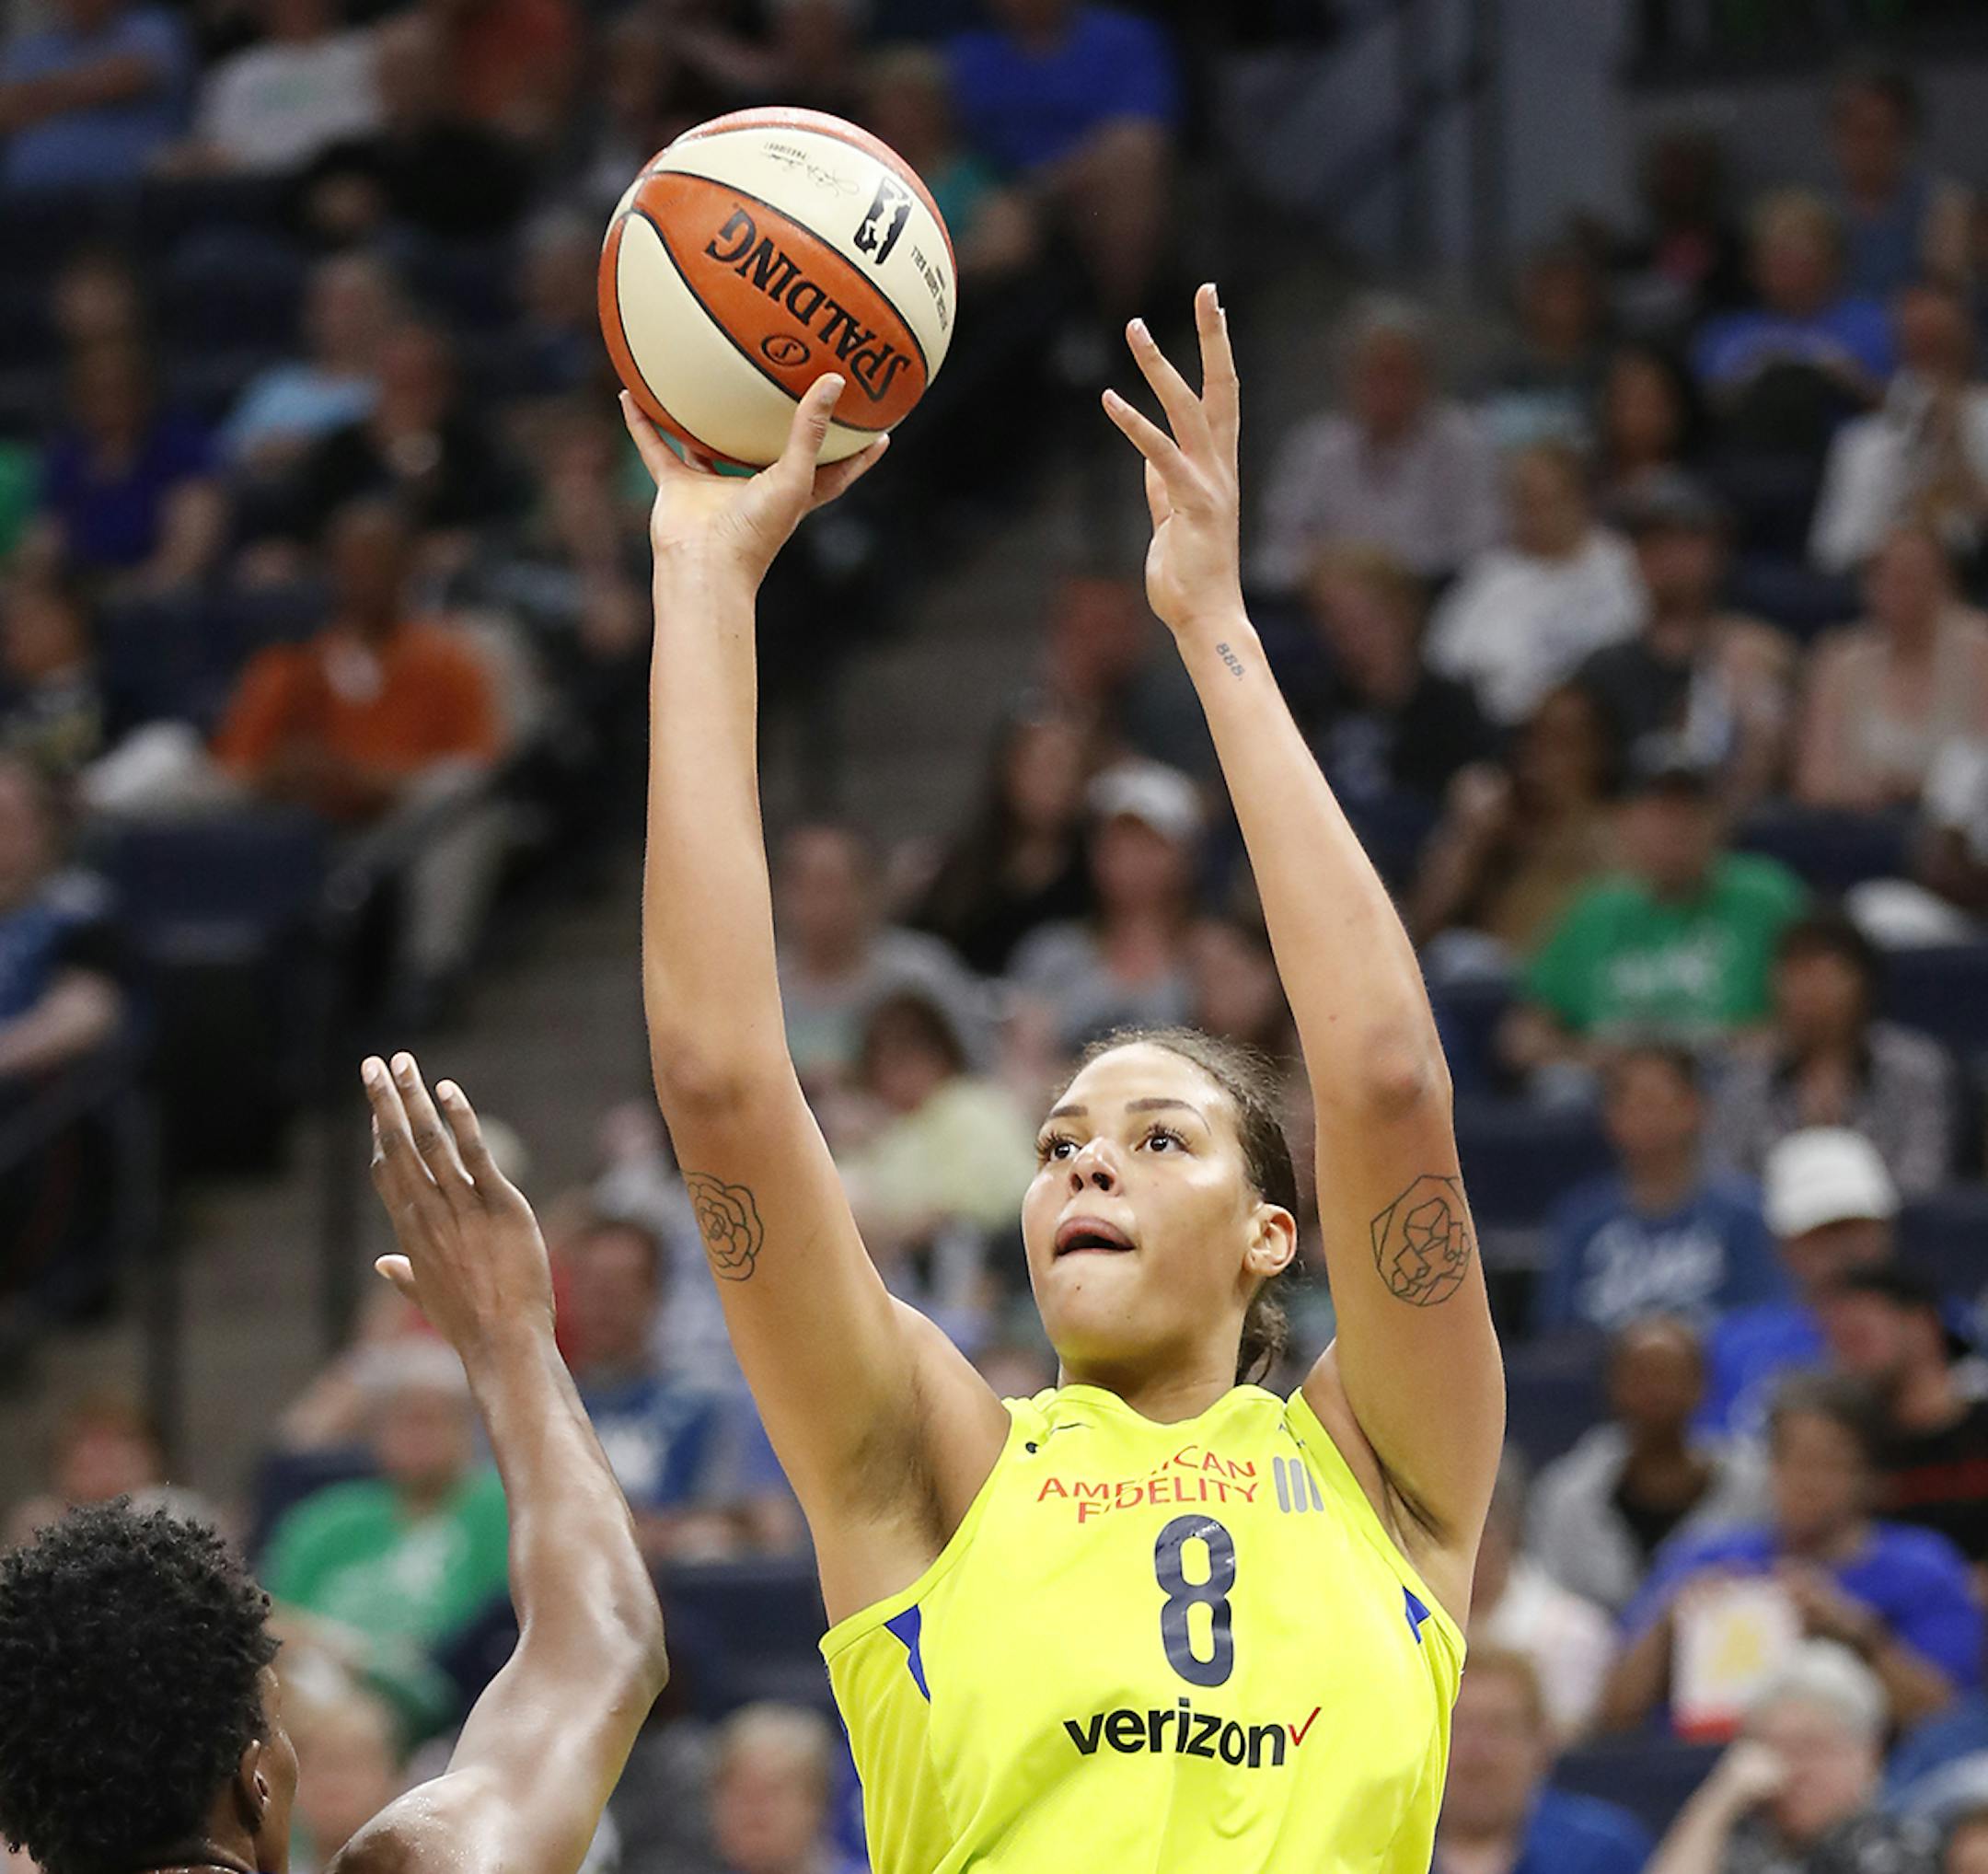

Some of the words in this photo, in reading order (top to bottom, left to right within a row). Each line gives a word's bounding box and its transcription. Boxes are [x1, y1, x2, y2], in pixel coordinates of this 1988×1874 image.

[705, 208, 911, 402] SPALDING
[1037, 1445, 1257, 1502] AMECAN
[1155, 1514, 1236, 1688] 8
[1063, 1697, 1286, 1768] verizon
